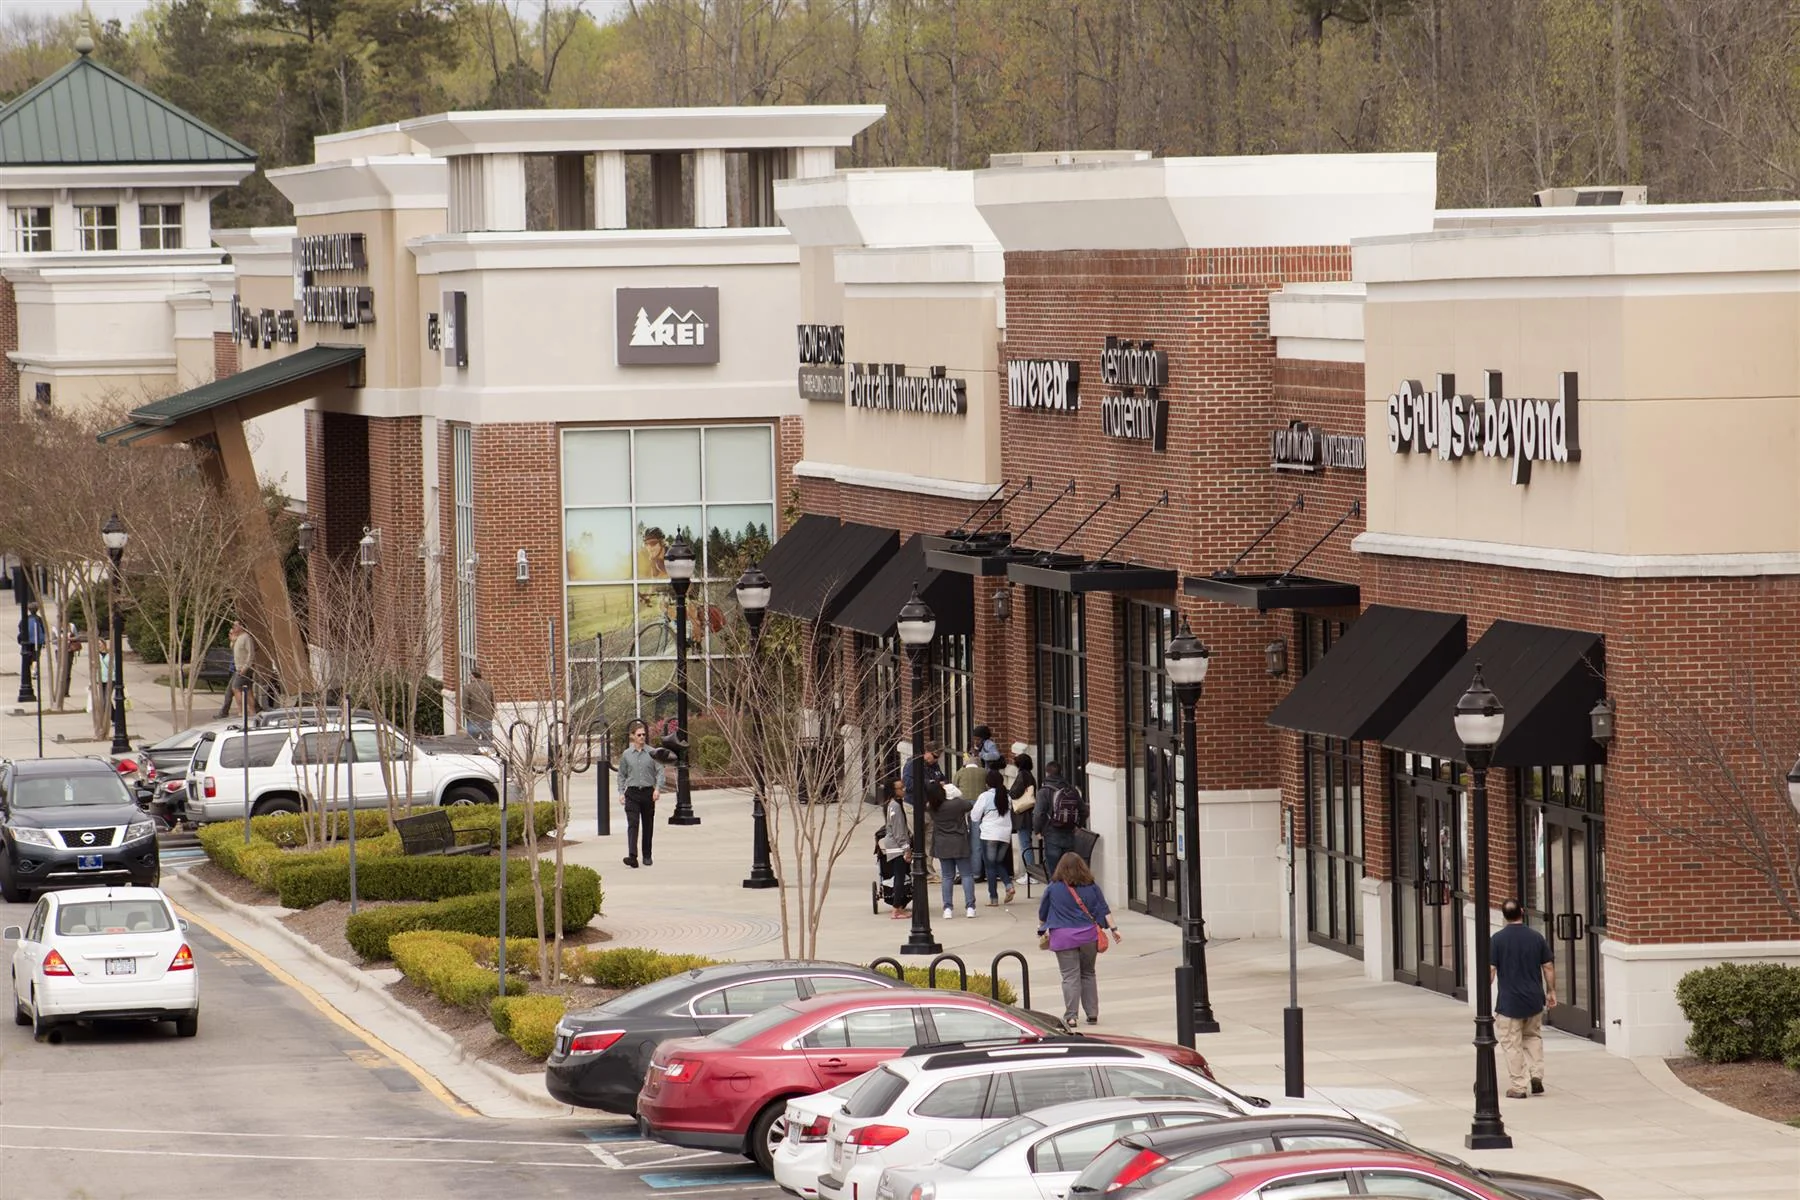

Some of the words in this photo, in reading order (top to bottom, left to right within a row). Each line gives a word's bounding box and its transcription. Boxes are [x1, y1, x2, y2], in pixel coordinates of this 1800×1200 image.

[827, 375, 844, 394] STUDIO
[1101, 336, 1160, 386] destination
[849, 363, 890, 410] Portrait
[892, 364, 959, 415] Innovations
[1101, 388, 1160, 453] maternity
[1387, 373, 1466, 461] scrubs
[1468, 403, 1480, 451] &
[1483, 369, 1569, 485] beyond
